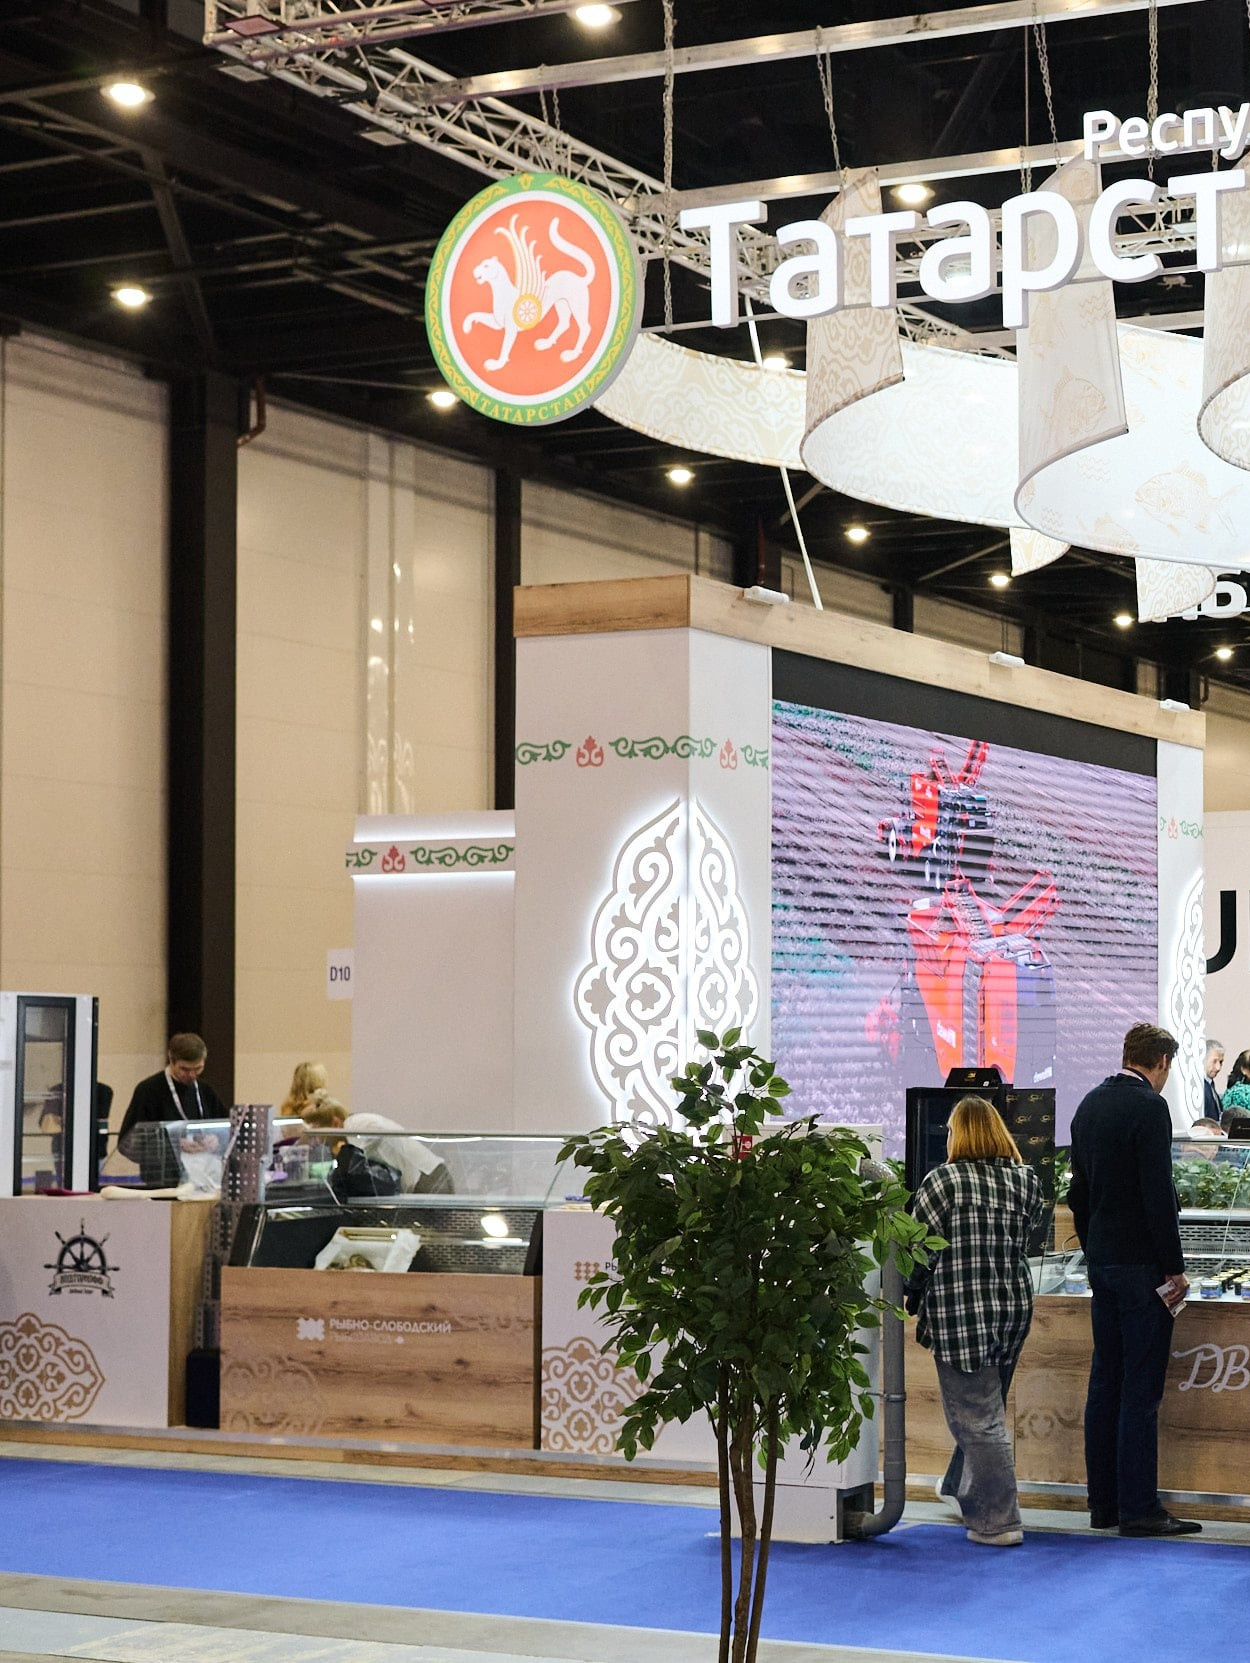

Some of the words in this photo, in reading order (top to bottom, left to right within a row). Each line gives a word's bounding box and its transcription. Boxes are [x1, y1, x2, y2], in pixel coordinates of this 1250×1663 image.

[480, 388, 588, 423] ТАТАРСТАН
[330, 966, 351, 981] D10
[329, 1318, 452, 1334] РЫБНО-СЛОБОДСКИЙ
[1171, 1343, 1250, 1393] DB
